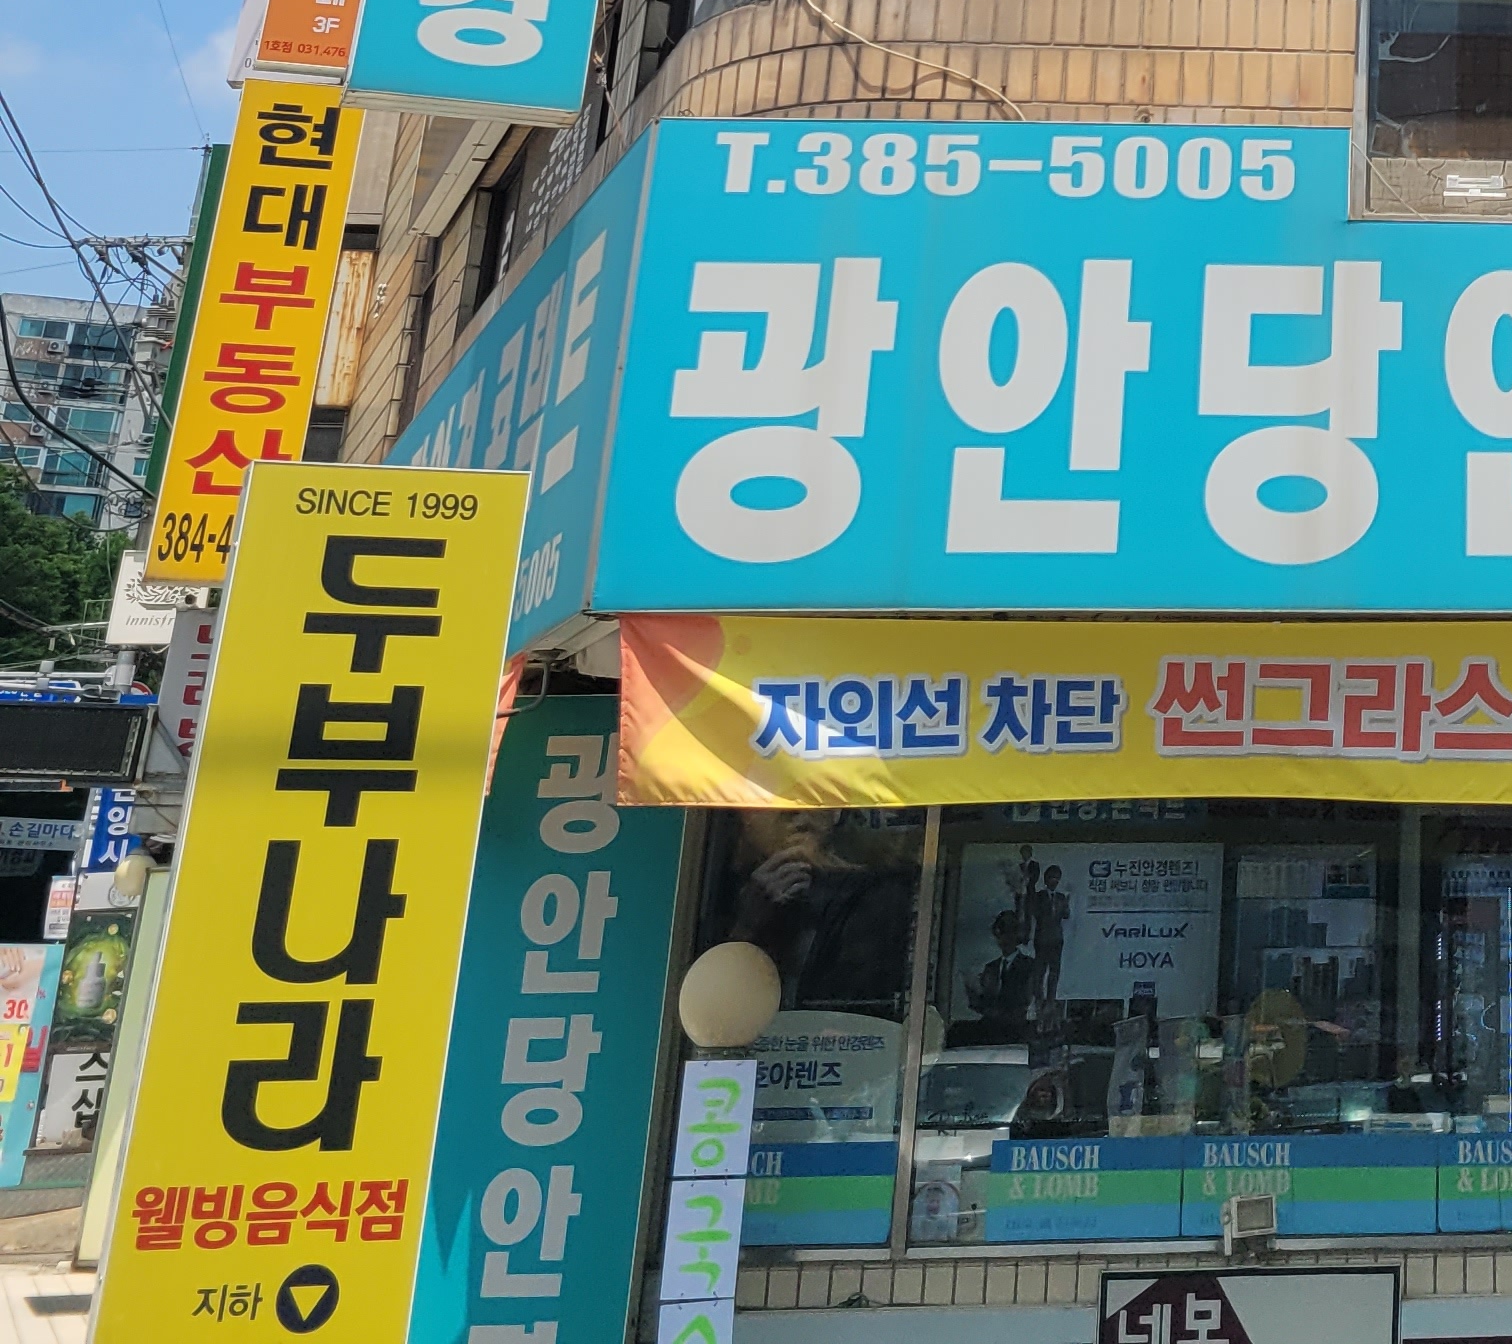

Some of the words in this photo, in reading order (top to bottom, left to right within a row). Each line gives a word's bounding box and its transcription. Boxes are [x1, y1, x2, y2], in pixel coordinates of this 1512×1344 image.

[312, 16, 341, 35] 3F
[264, 39, 293, 56] 1호점
[716, 131, 1295, 202] T.385-5005
[295, 486, 393, 518] SINCE
[406, 491, 479, 521] 1999
[754, 676, 964, 754] 자외선
[984, 676, 1124, 750] 차단
[221, 535, 448, 1152] 두부나라
[1119, 952, 1175, 969] HOYA
[1011, 1145, 1100, 1172] BAUSCH
[1203, 1142, 1292, 1168] BAUSCH
[1457, 1169, 1473, 1193] &
[132, 1179, 408, 1252] 웰빙음식점
[191, 1284, 263, 1323] 지하
